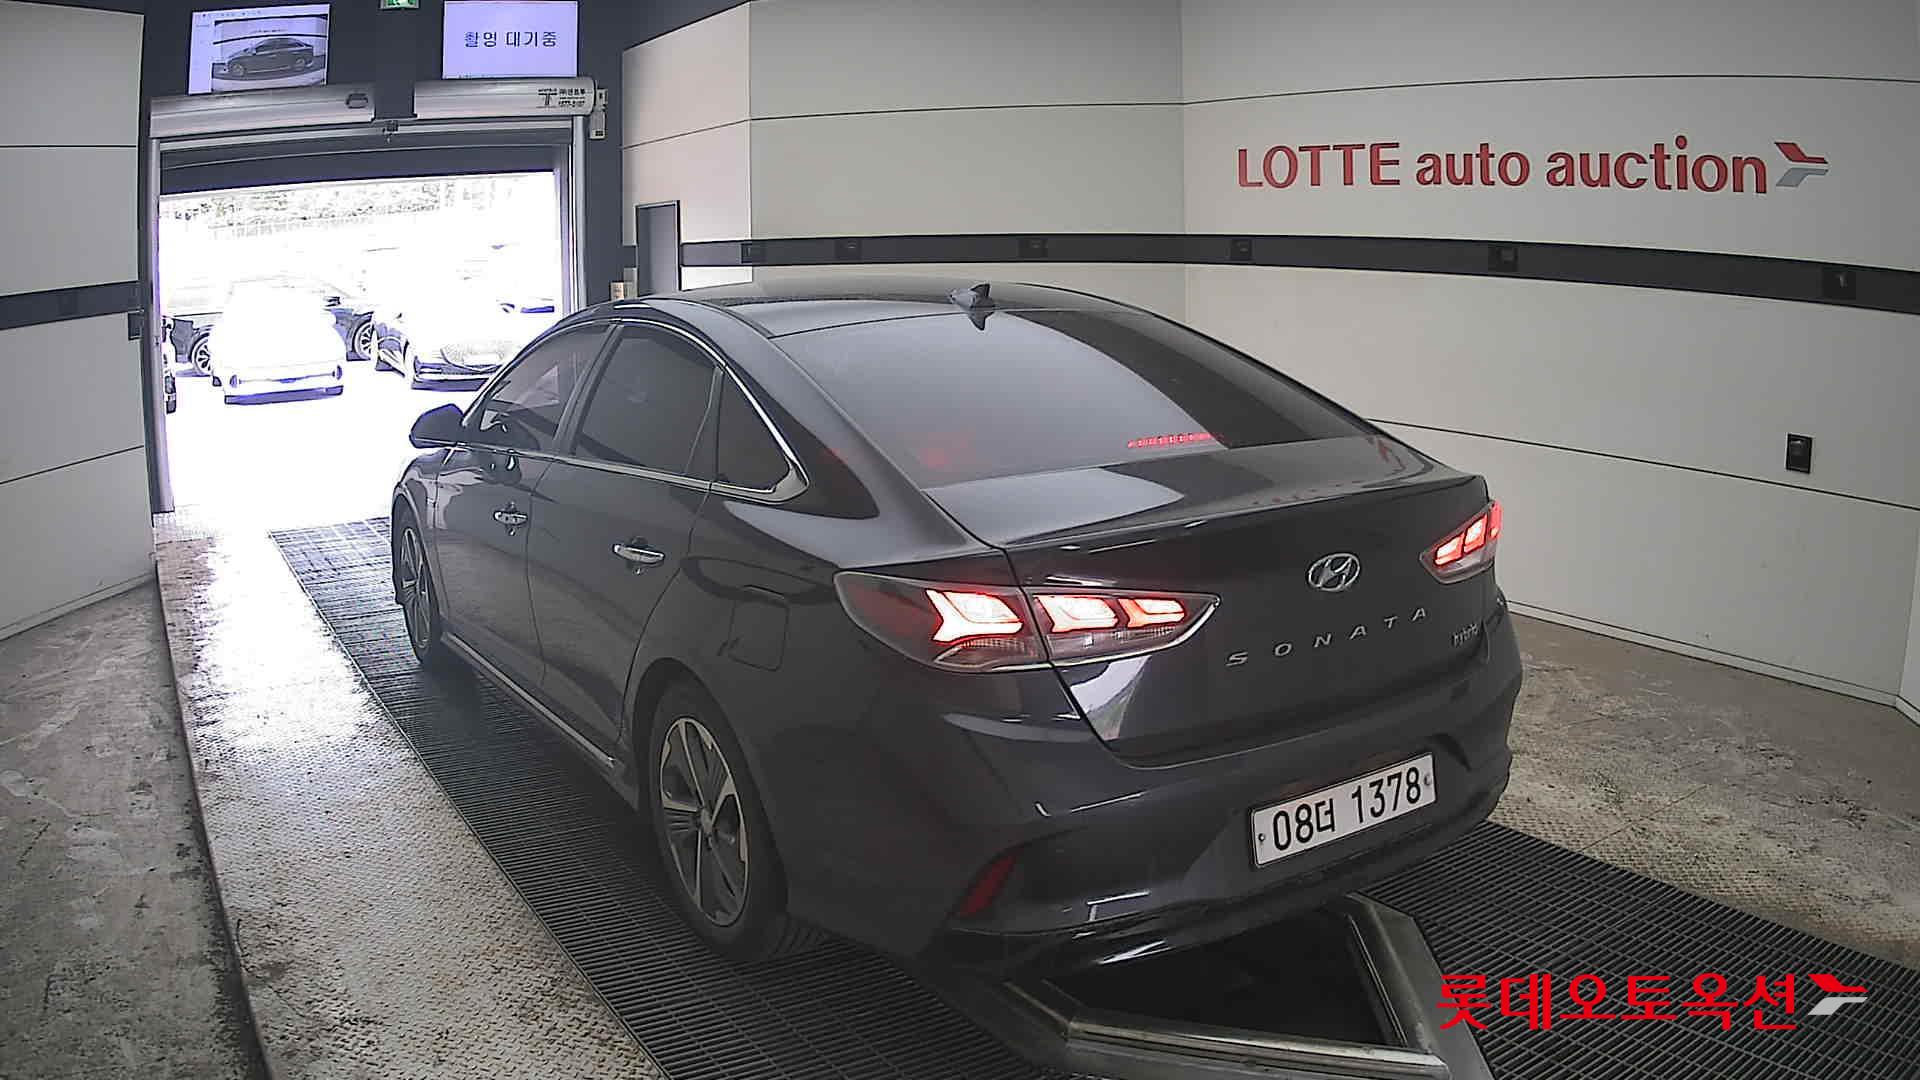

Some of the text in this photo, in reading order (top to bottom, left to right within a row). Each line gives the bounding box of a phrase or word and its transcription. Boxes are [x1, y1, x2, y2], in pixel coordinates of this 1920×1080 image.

[506, 31, 558, 48] 대기중
[1237, 135, 1767, 194] LOTTE auto auction
[1225, 607, 1427, 667] SONATA
[1272, 766, 1421, 851] 08더 1378
